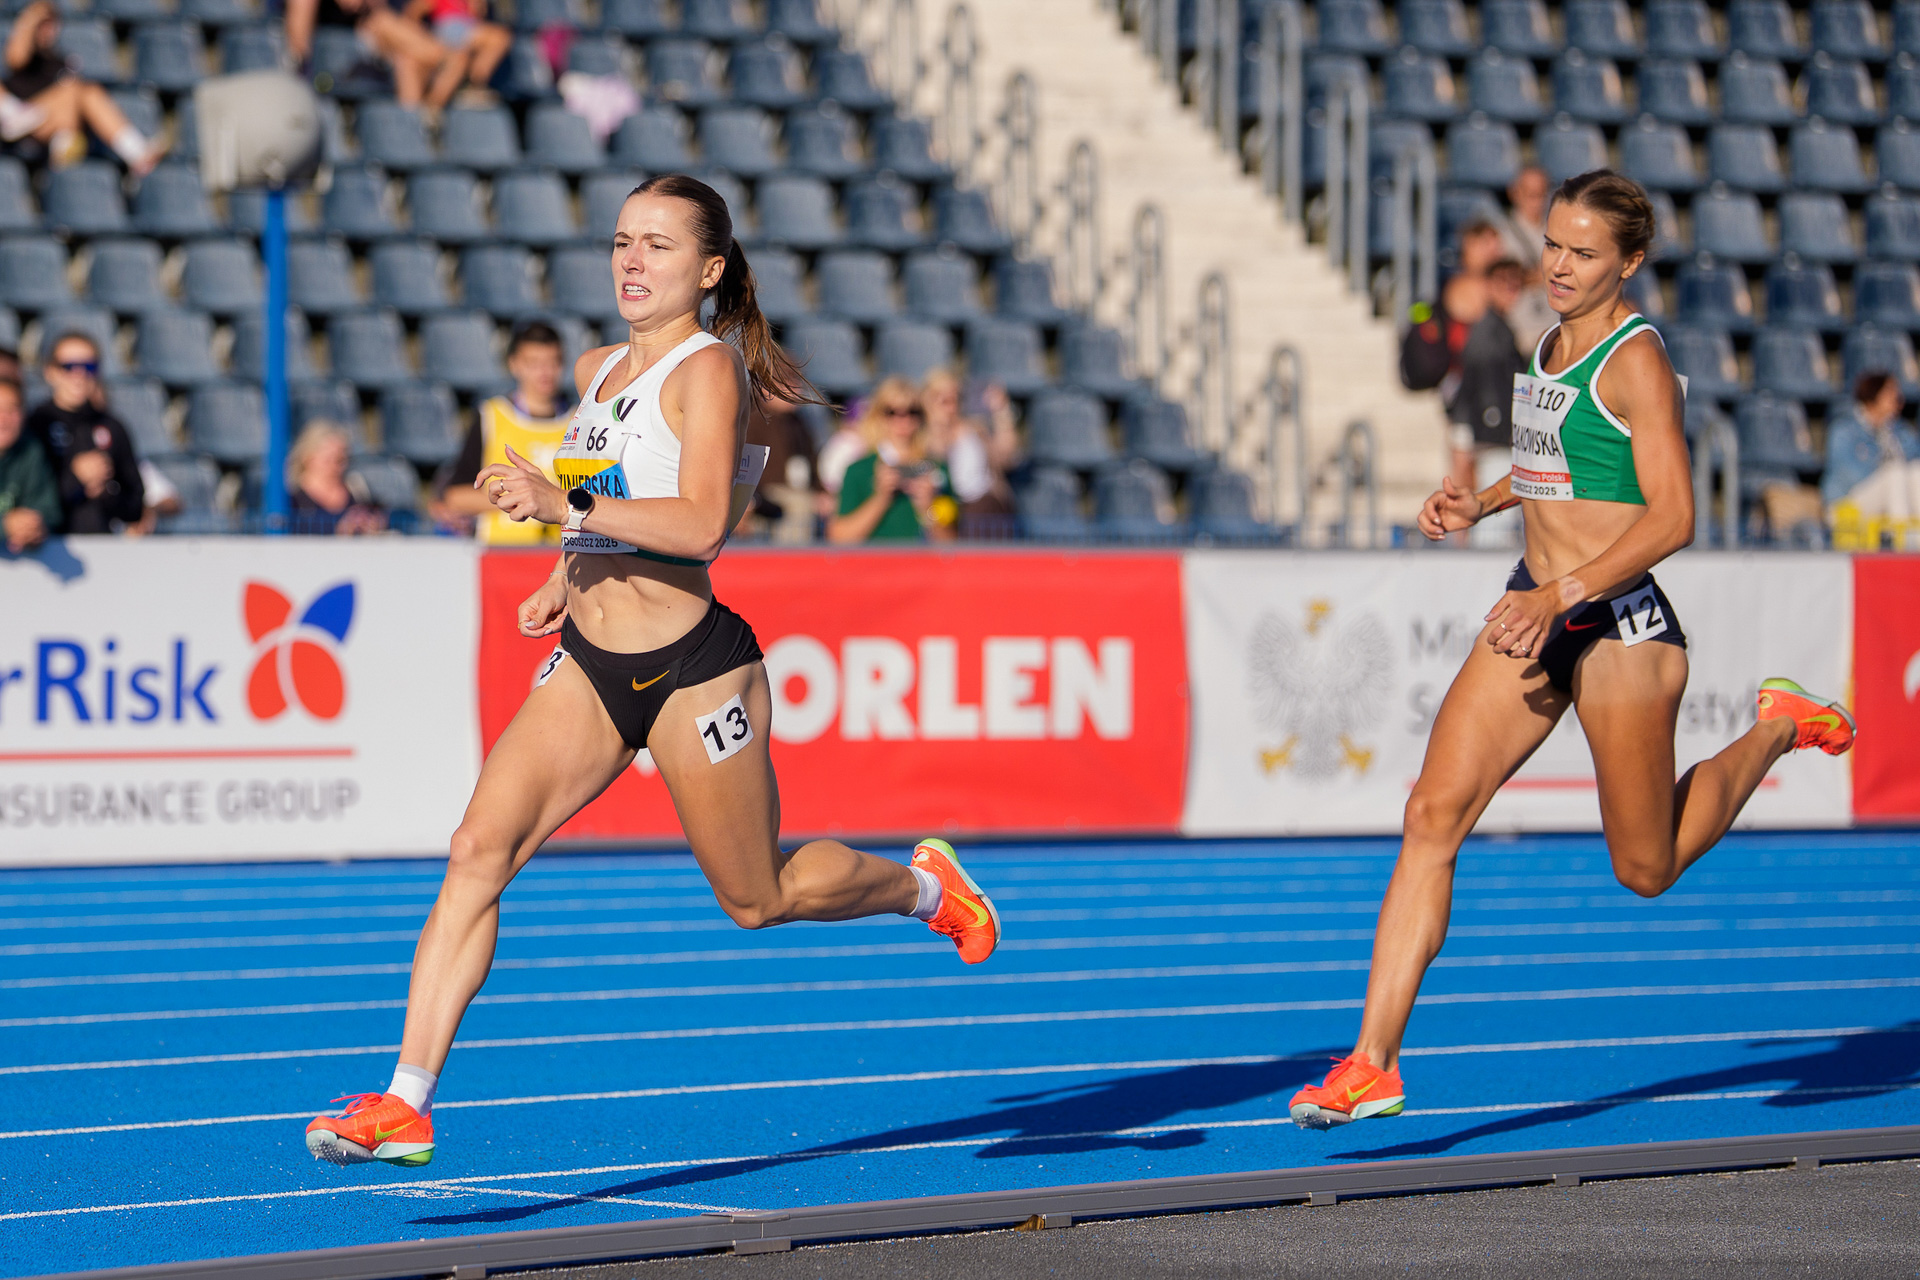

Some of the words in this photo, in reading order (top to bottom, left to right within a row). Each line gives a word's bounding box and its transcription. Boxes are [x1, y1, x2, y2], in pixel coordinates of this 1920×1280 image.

[1536, 387, 1565, 411] 110
[586, 426, 609, 451] 66
[1534, 485, 1557, 495] 2025
[595, 537, 618, 548] 2025
[1619, 595, 1662, 636] 12
[764, 634, 1134, 745] ORLEN
[703, 706, 748, 752] 13
[216, 777, 359, 824] GROUP
